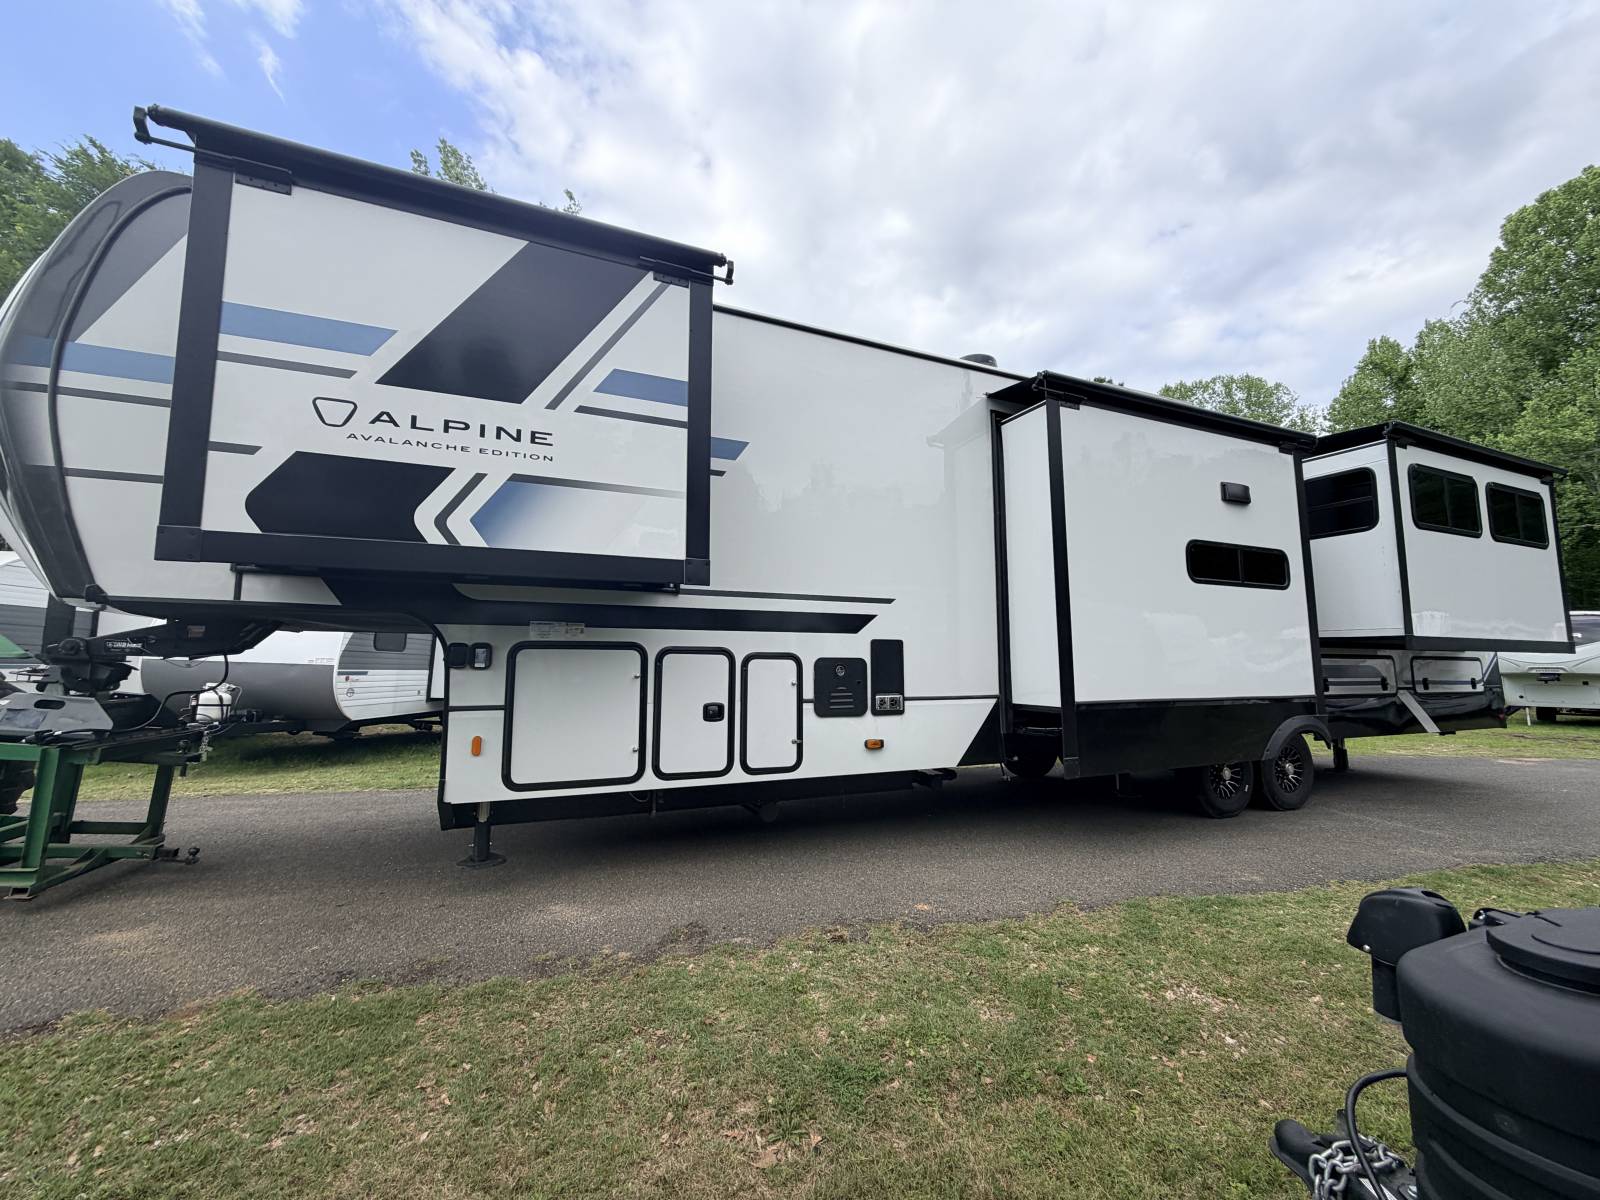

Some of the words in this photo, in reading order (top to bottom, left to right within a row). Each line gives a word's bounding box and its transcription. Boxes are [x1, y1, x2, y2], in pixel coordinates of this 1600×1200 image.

[368, 411, 554, 446] ALPINE
[346, 433, 471, 453] AVALANCHE
[478, 447, 554, 462] EDITION
